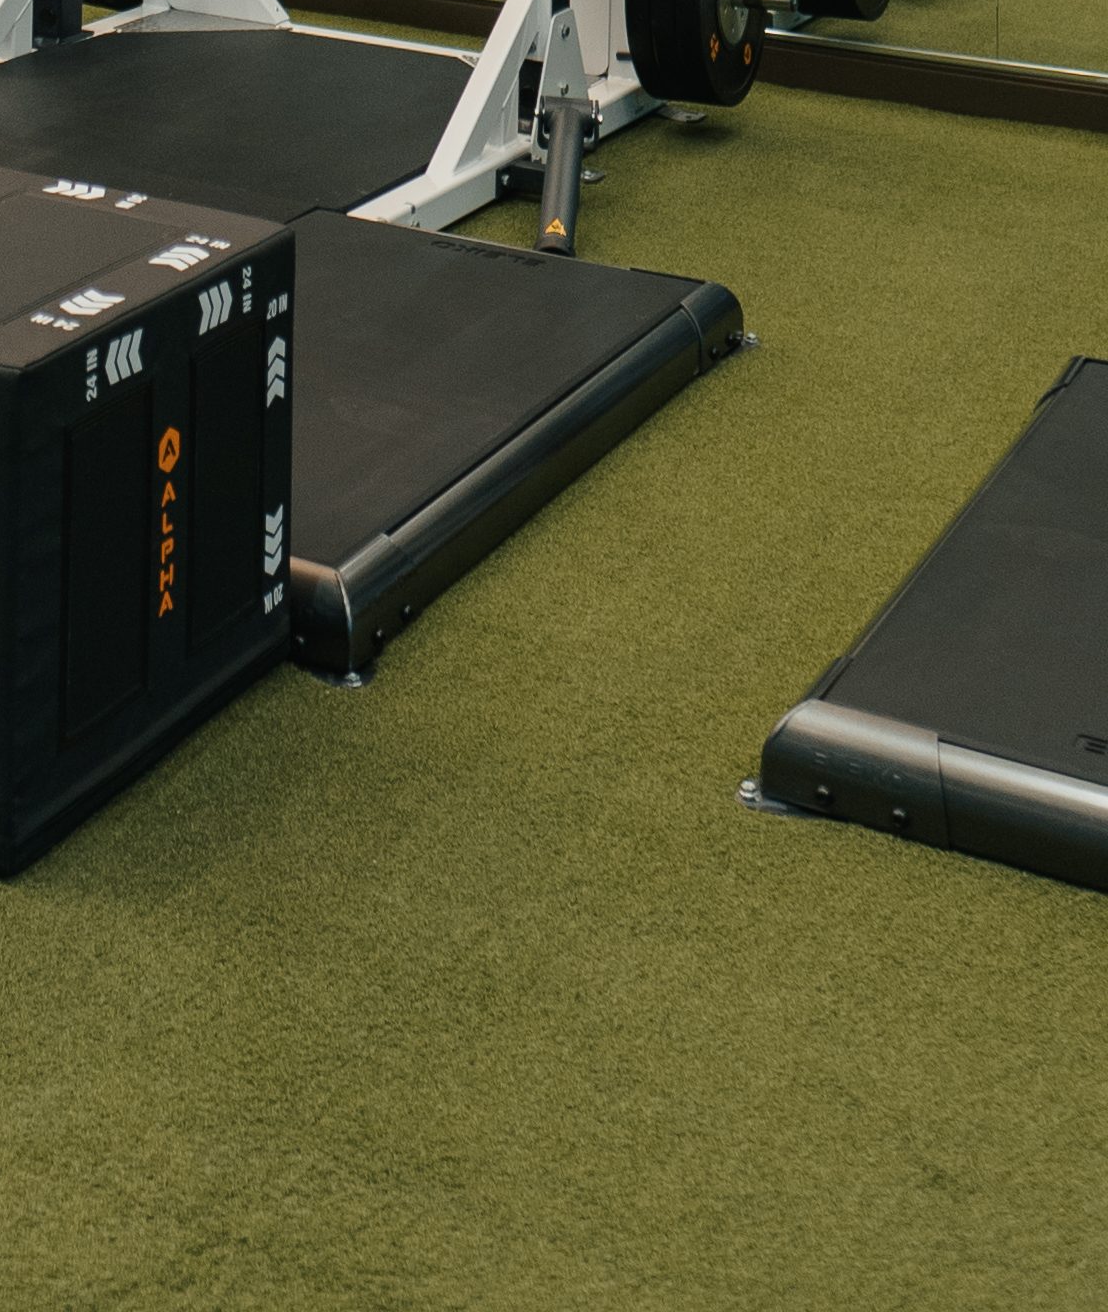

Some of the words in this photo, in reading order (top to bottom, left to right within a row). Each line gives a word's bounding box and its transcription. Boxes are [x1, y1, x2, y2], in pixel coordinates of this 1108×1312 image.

[242, 265, 252, 290] 24
[242, 293, 252, 314] IN
[266, 298, 278, 321] 20
[278, 292, 289, 314] IN
[86, 347, 98, 373] IN
[86, 374, 98, 403] 24
[158, 479, 177, 618] ALPHA
[263, 591, 273, 616] IN
[273, 581, 284, 607] 20
